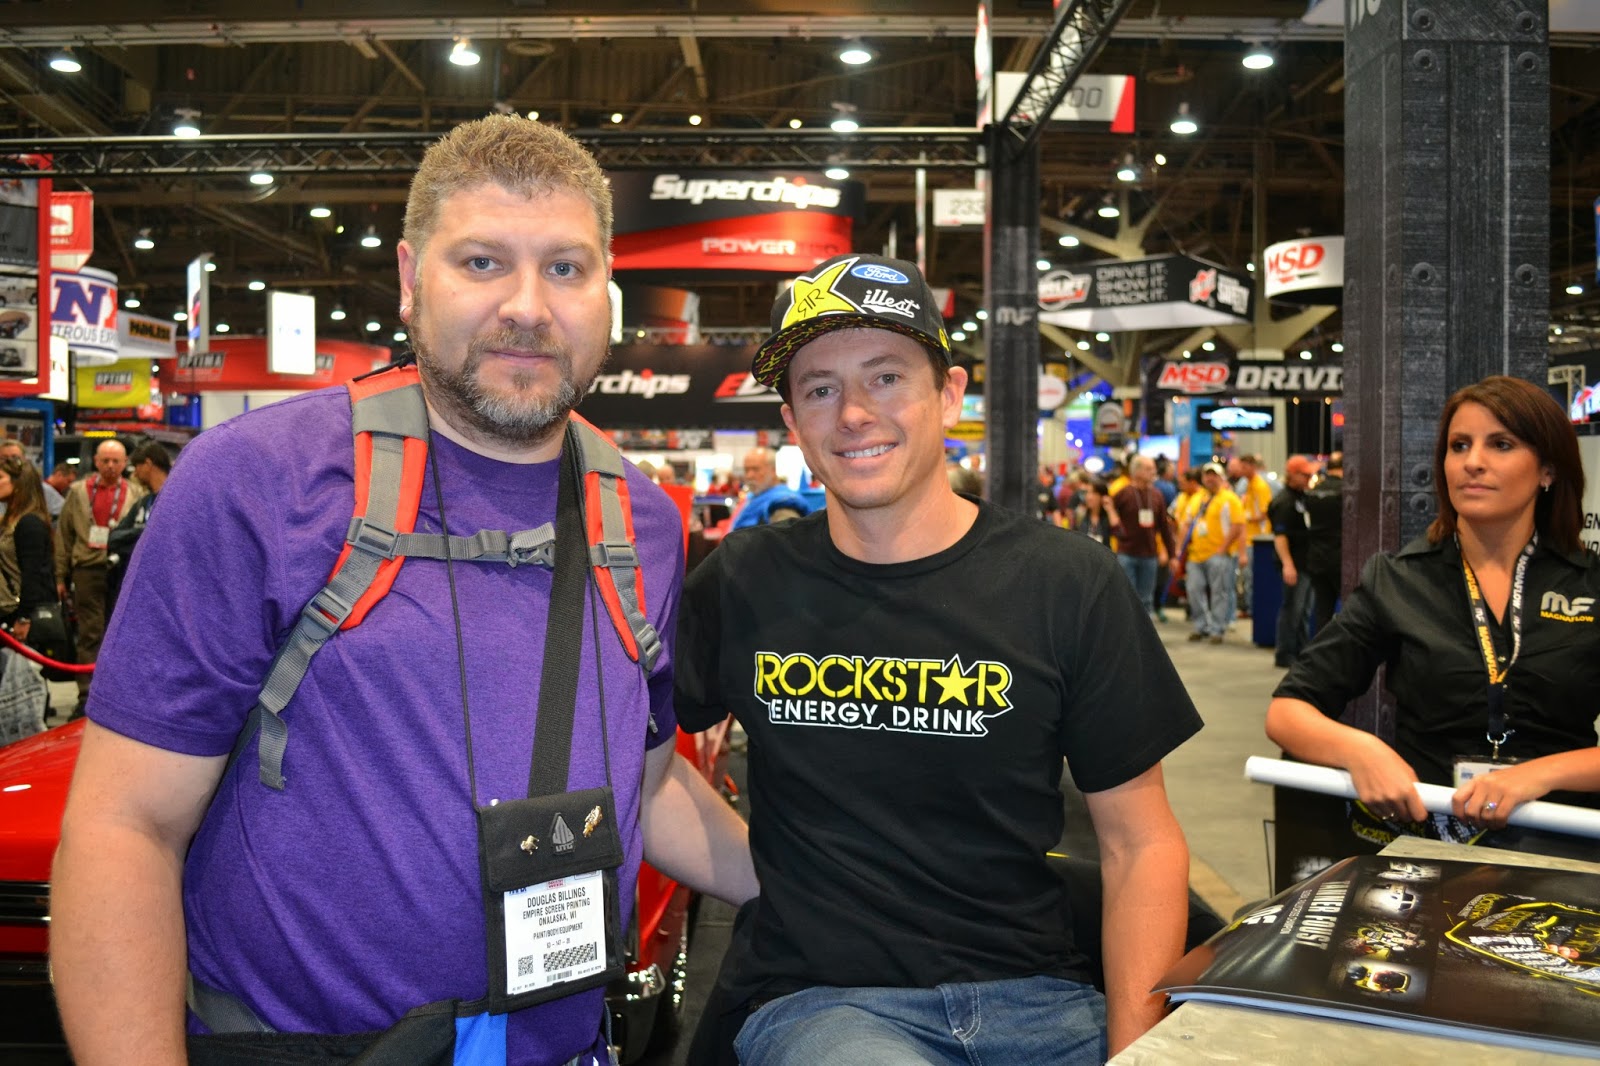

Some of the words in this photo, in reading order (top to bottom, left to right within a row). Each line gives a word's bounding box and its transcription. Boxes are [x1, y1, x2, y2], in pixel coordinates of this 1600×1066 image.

[650, 173, 841, 209] Superchips
[1268, 244, 1325, 273] MSD
[864, 265, 898, 282] Ford
[1096, 264, 1148, 281] DRIVE
[1097, 277, 1149, 294] SHOW
[863, 289, 920, 316] illest
[1098, 290, 1149, 306] TRACK
[1160, 364, 1229, 384] MSD
[1236, 366, 1343, 391] DRIVI
[1540, 611, 1595, 623] MAGNAFLOW
[755, 653, 1010, 707] ROCKSTAR
[770, 698, 879, 725] ENERGY
[892, 705, 985, 732] DRINK
[527, 893, 557, 908] DOUGLAS
[558, 887, 586, 902] BILLINGS
[1307, 880, 1351, 913] TANNER
[523, 908, 543, 919] EMPIRE
[545, 903, 565, 915] SCREEN
[567, 898, 590, 910] PRINTING
[1293, 914, 1338, 950] FOUST
